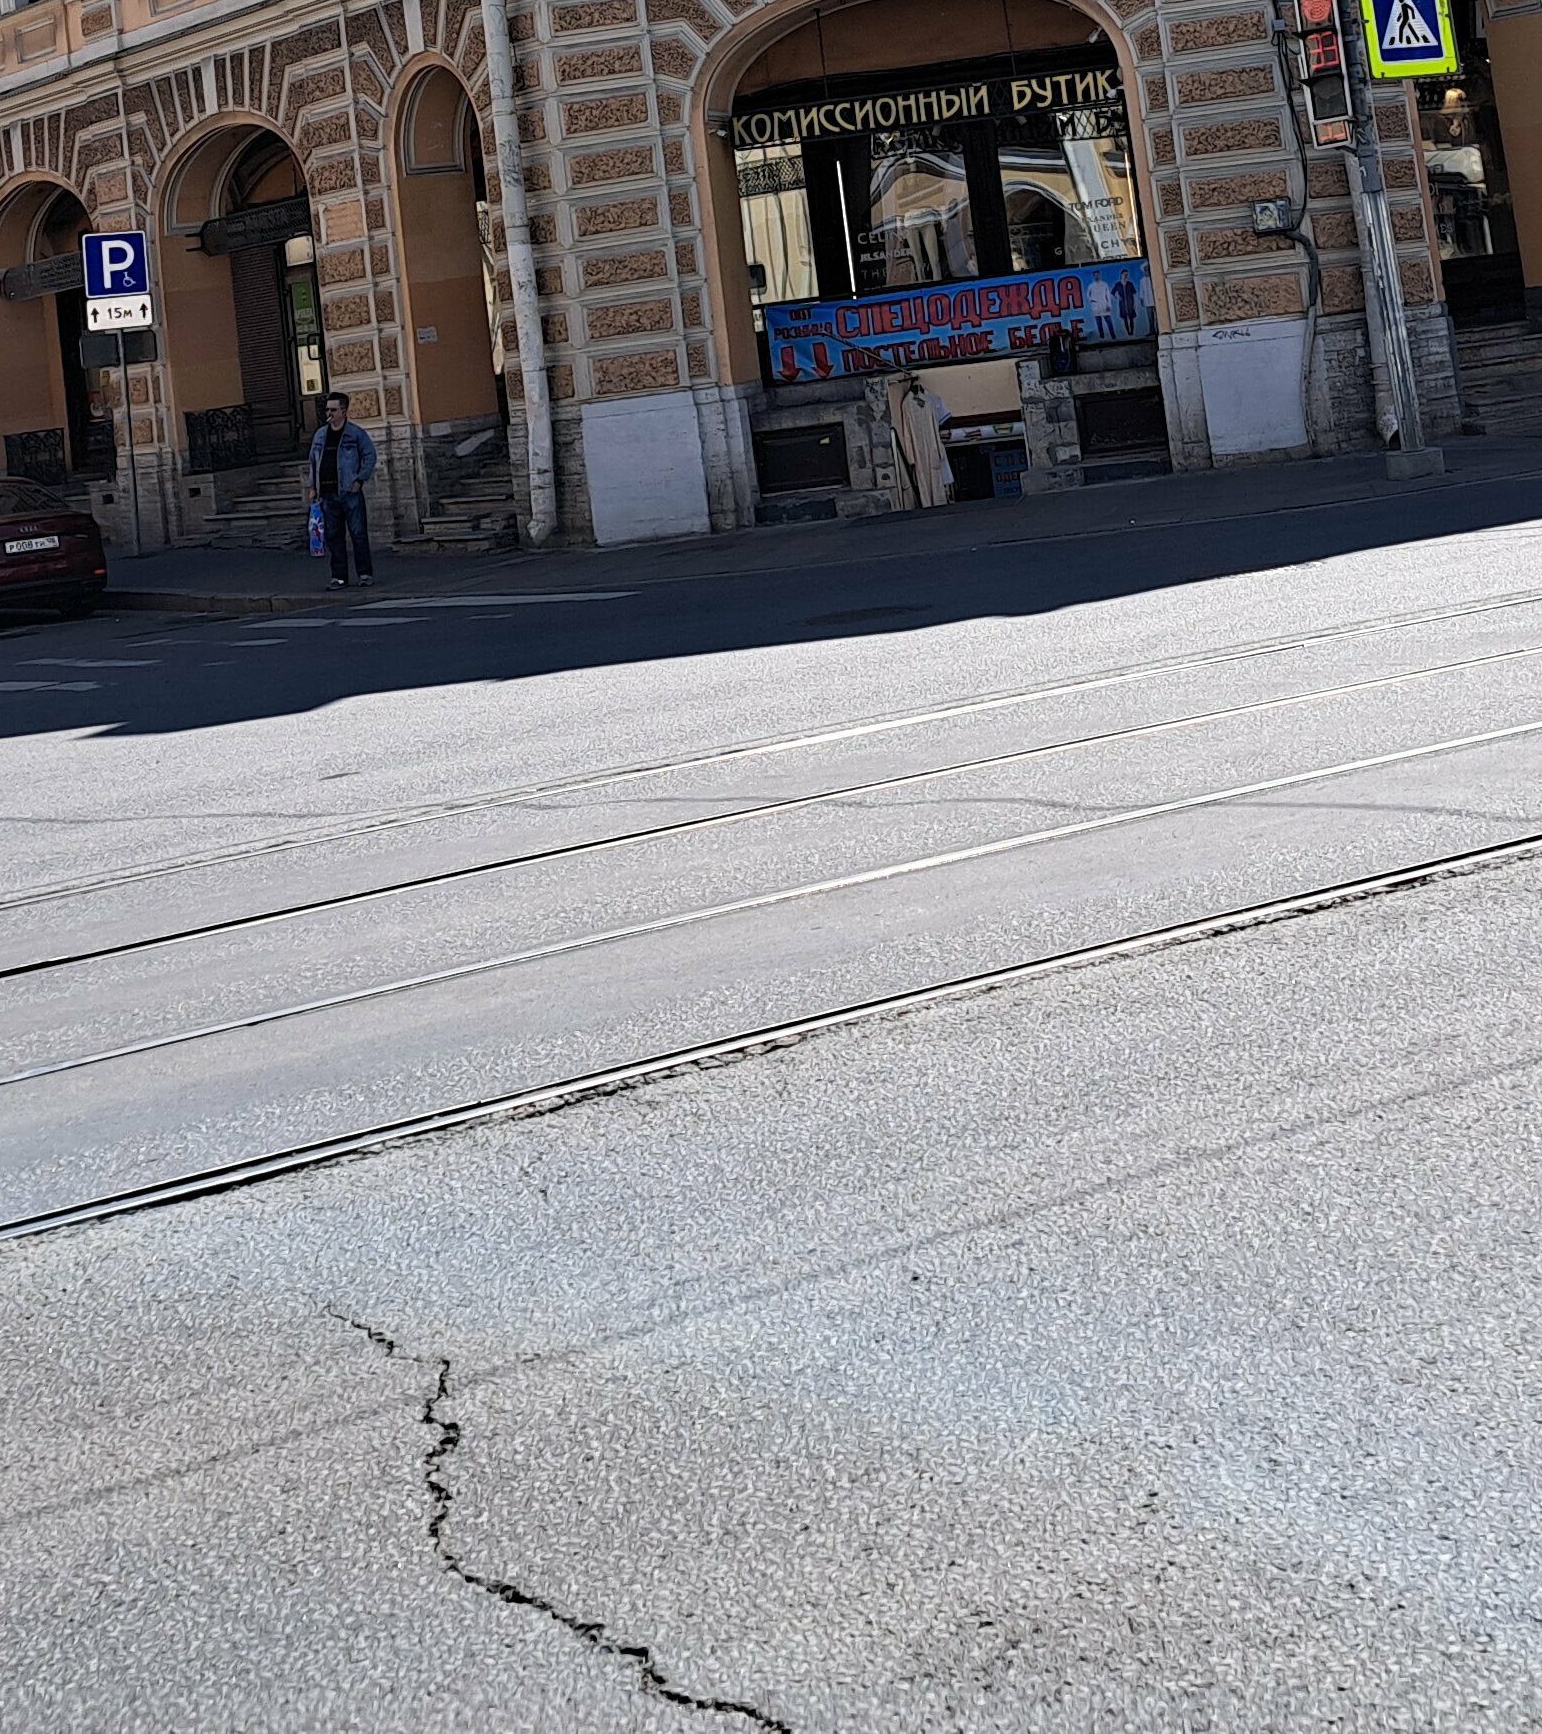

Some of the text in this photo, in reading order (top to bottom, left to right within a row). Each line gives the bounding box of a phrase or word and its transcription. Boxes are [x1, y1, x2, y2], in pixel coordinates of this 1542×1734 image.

[732, 69, 1117, 146] КОМИССИОННЫЙ БУТИК
[101, 239, 134, 289] P
[835, 275, 1085, 339] СПЕЦОДЕЖДА
[843, 330, 993, 372] ПОСТЕЛЬНОЕ
